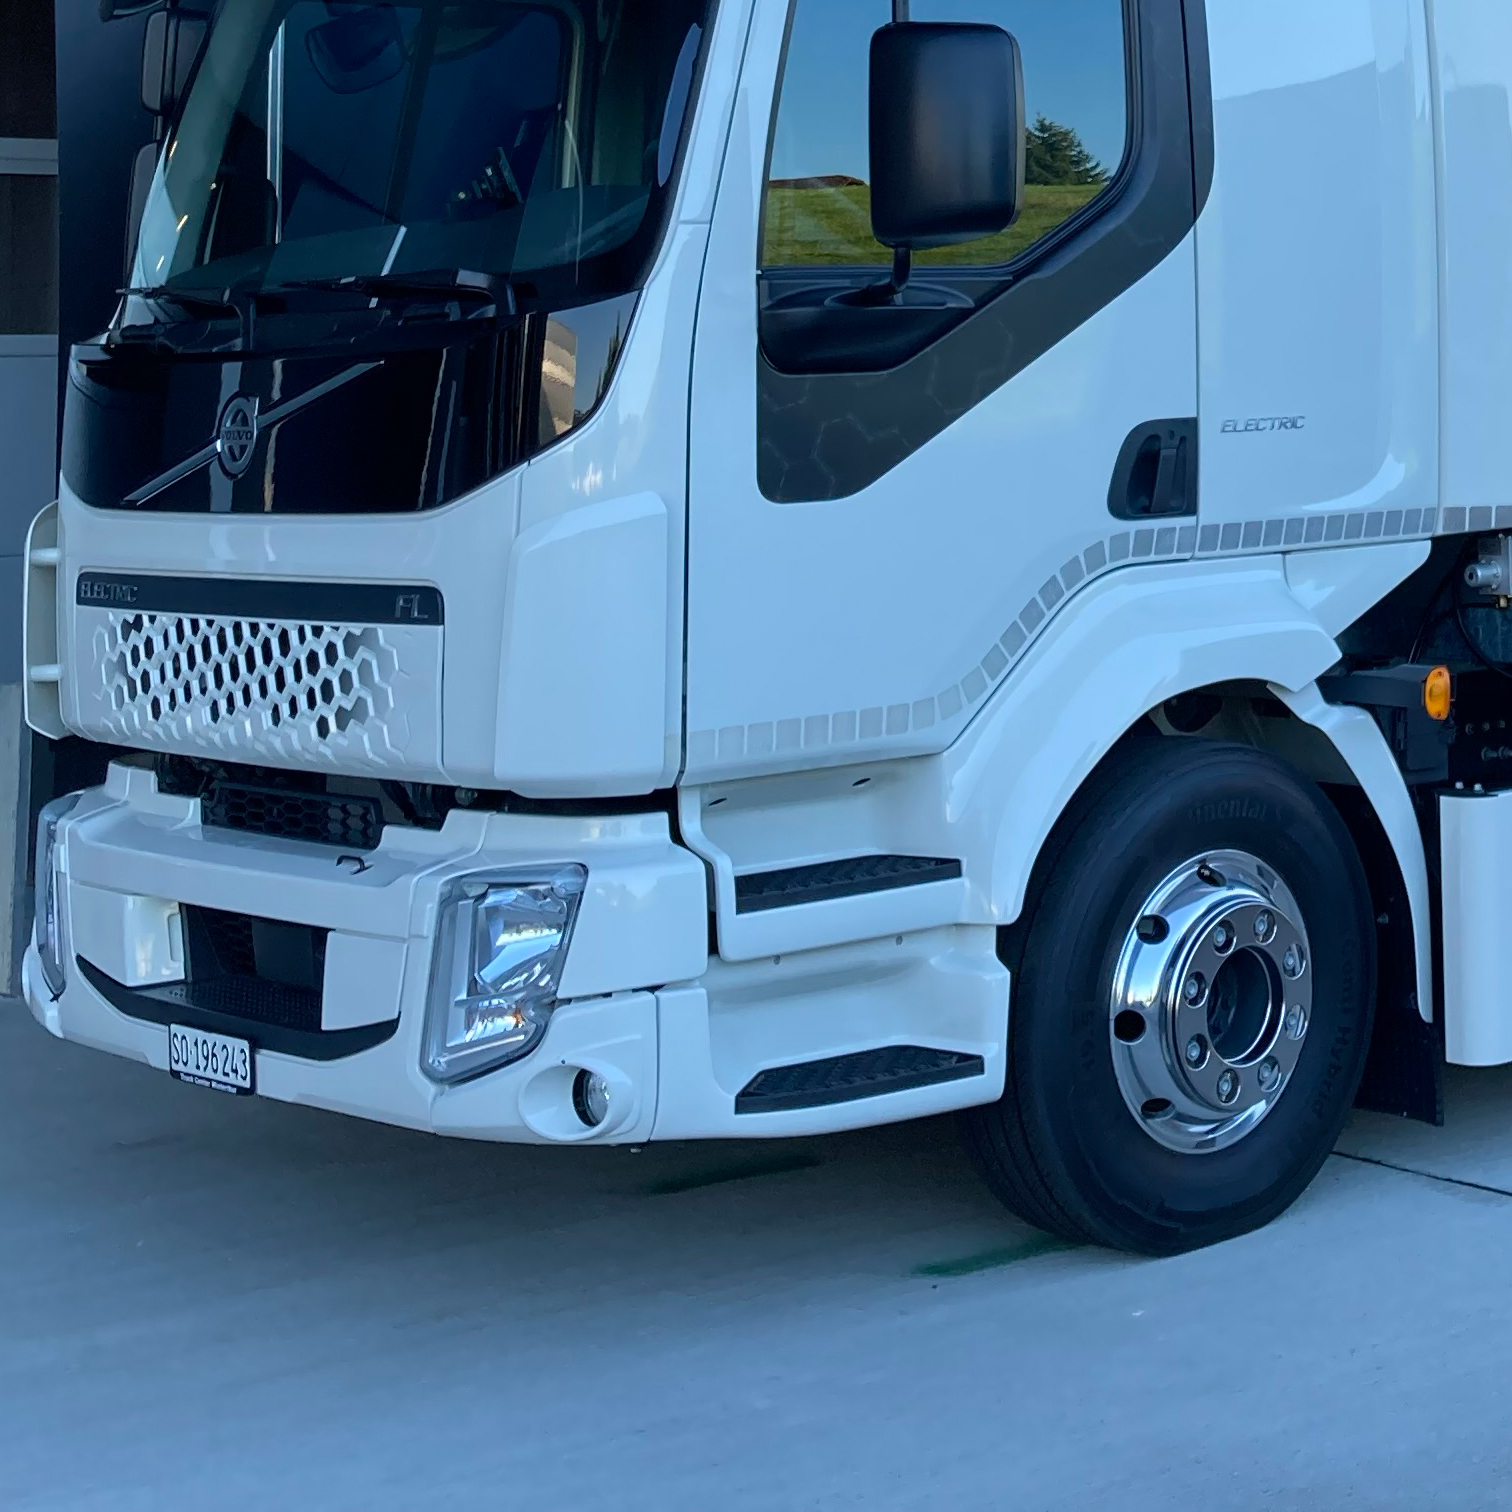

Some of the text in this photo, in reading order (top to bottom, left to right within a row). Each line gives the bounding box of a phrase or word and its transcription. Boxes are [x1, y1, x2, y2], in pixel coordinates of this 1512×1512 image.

[1220, 415, 1305, 433] ELECTRIC
[221, 429, 253, 441] VOLVO
[80, 580, 138, 602] ELECTRIC
[394, 593, 430, 619] FL
